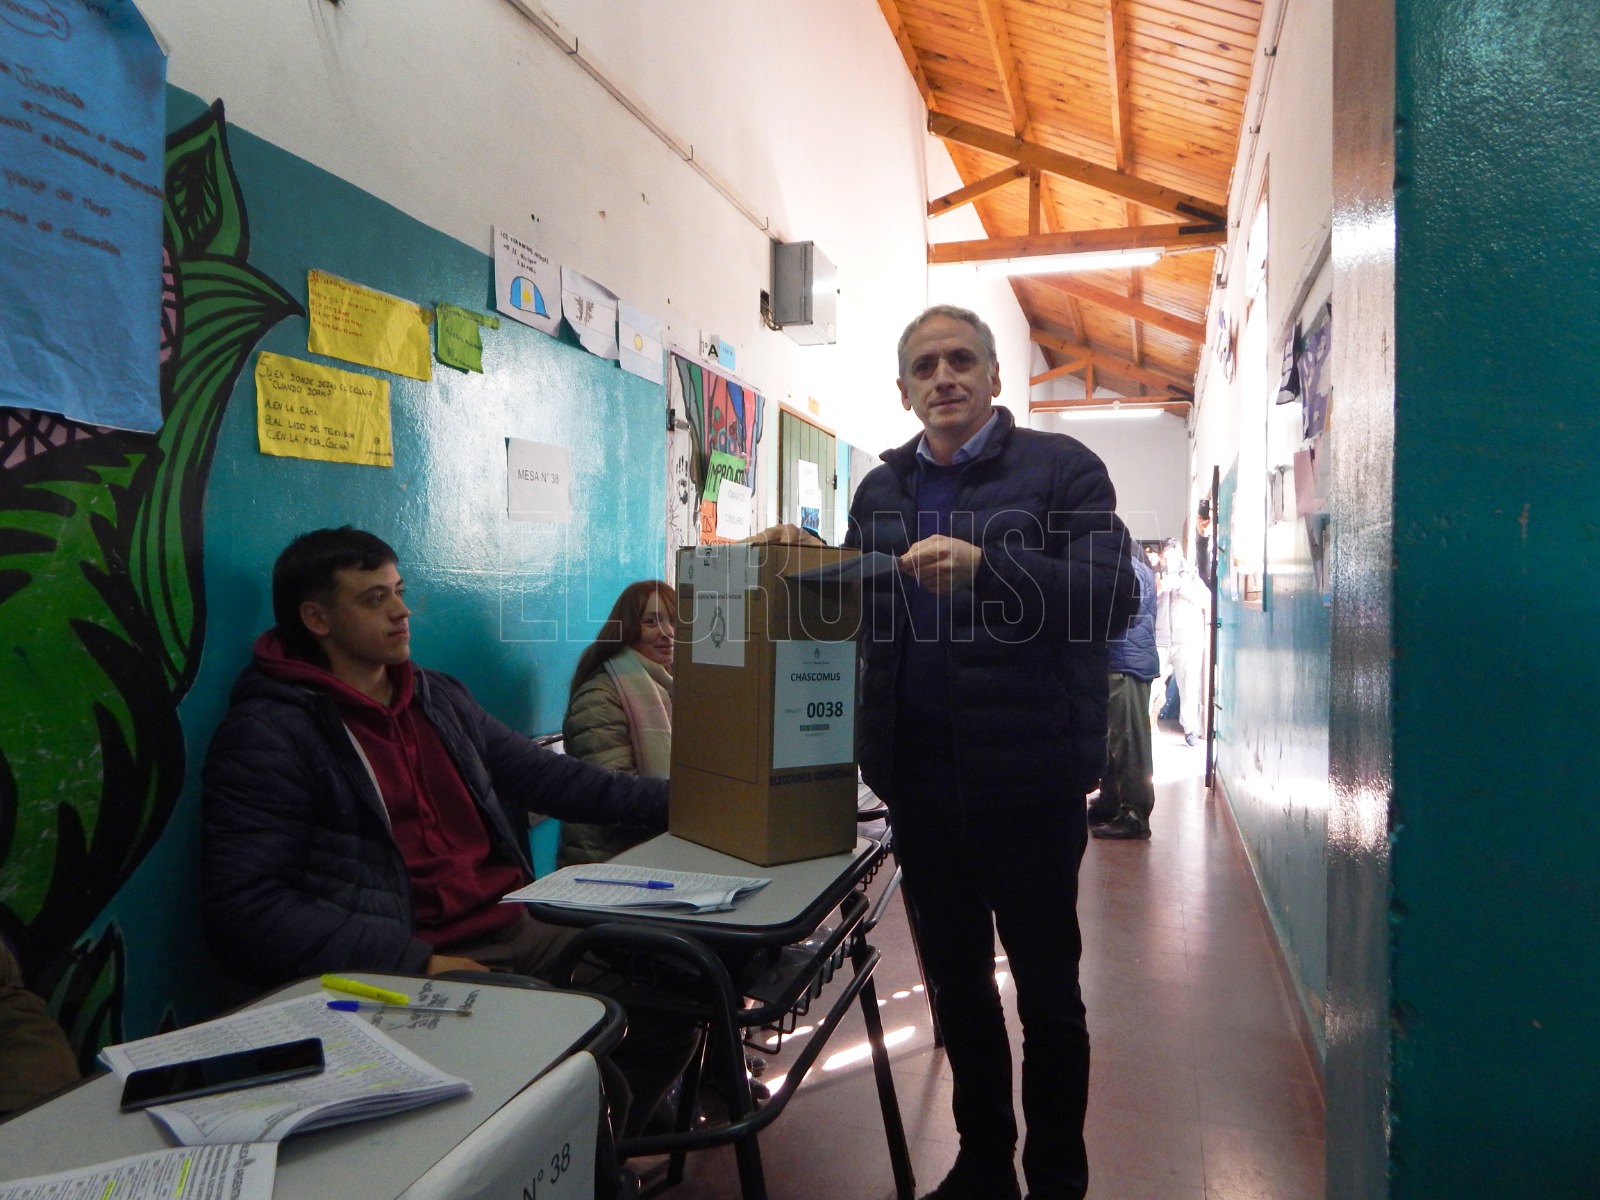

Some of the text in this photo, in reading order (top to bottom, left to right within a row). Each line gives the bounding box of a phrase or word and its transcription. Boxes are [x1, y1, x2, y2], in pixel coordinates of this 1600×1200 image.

[708, 344, 719, 358] A
[258, 355, 269, 377] 5
[272, 380, 302, 393] CUANDO
[285, 402, 294, 413] LA
[290, 433, 299, 442] LA
[517, 469, 540, 482] MESA
[551, 473, 560, 484] 38
[790, 672, 841, 682] CHASCOMUS
[806, 701, 844, 719] 0038
[550, 1142, 571, 1184] 38
